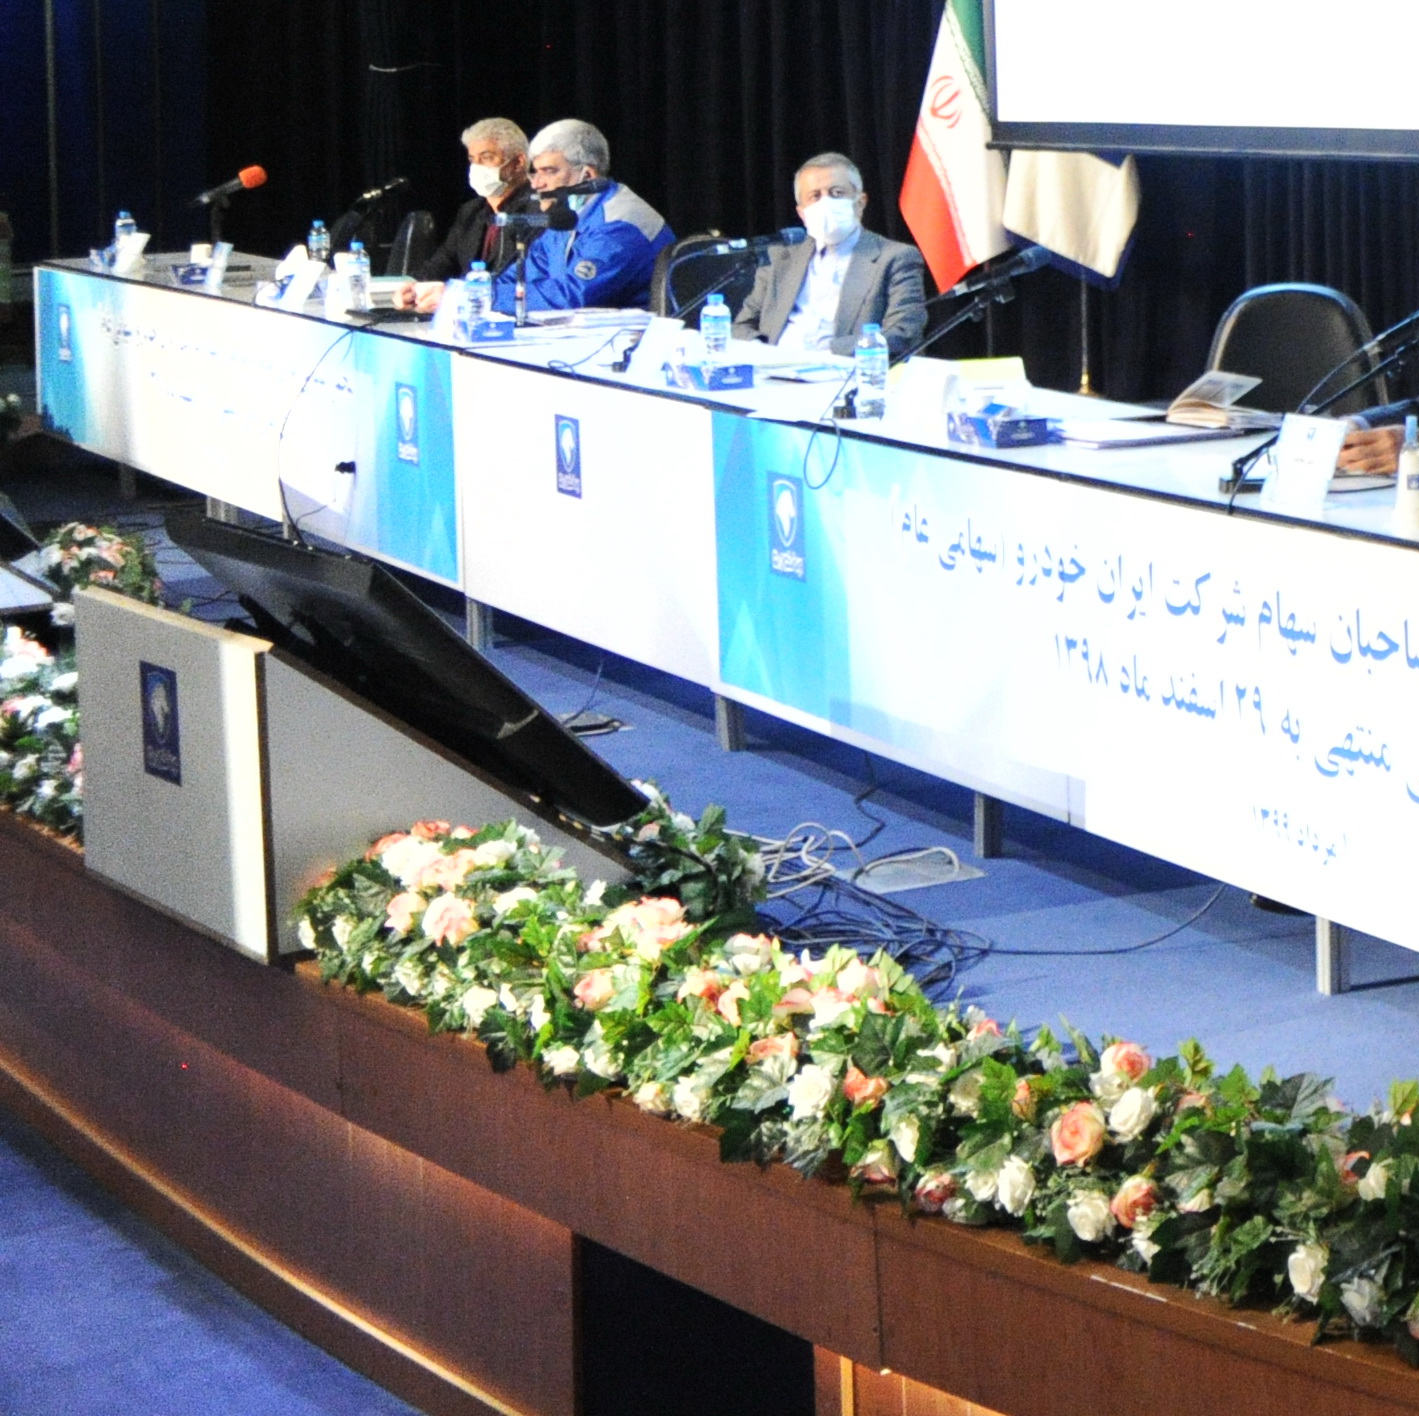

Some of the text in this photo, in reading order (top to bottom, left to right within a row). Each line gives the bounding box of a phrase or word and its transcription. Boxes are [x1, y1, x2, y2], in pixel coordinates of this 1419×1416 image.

[1016, 544, 1086, 602] خودرو
[1097, 554, 1153, 620] ایران
[1164, 572, 1246, 644] شرکت
[1259, 591, 1316, 656] سهام
[1055, 634, 1109, 687] ۱۳۹۸
[1161, 672, 1224, 719] اسفند
[1235, 685, 1266, 735] ۲۹
[1281, 709, 1300, 760] به
[1314, 726, 1391, 777] منتهی
